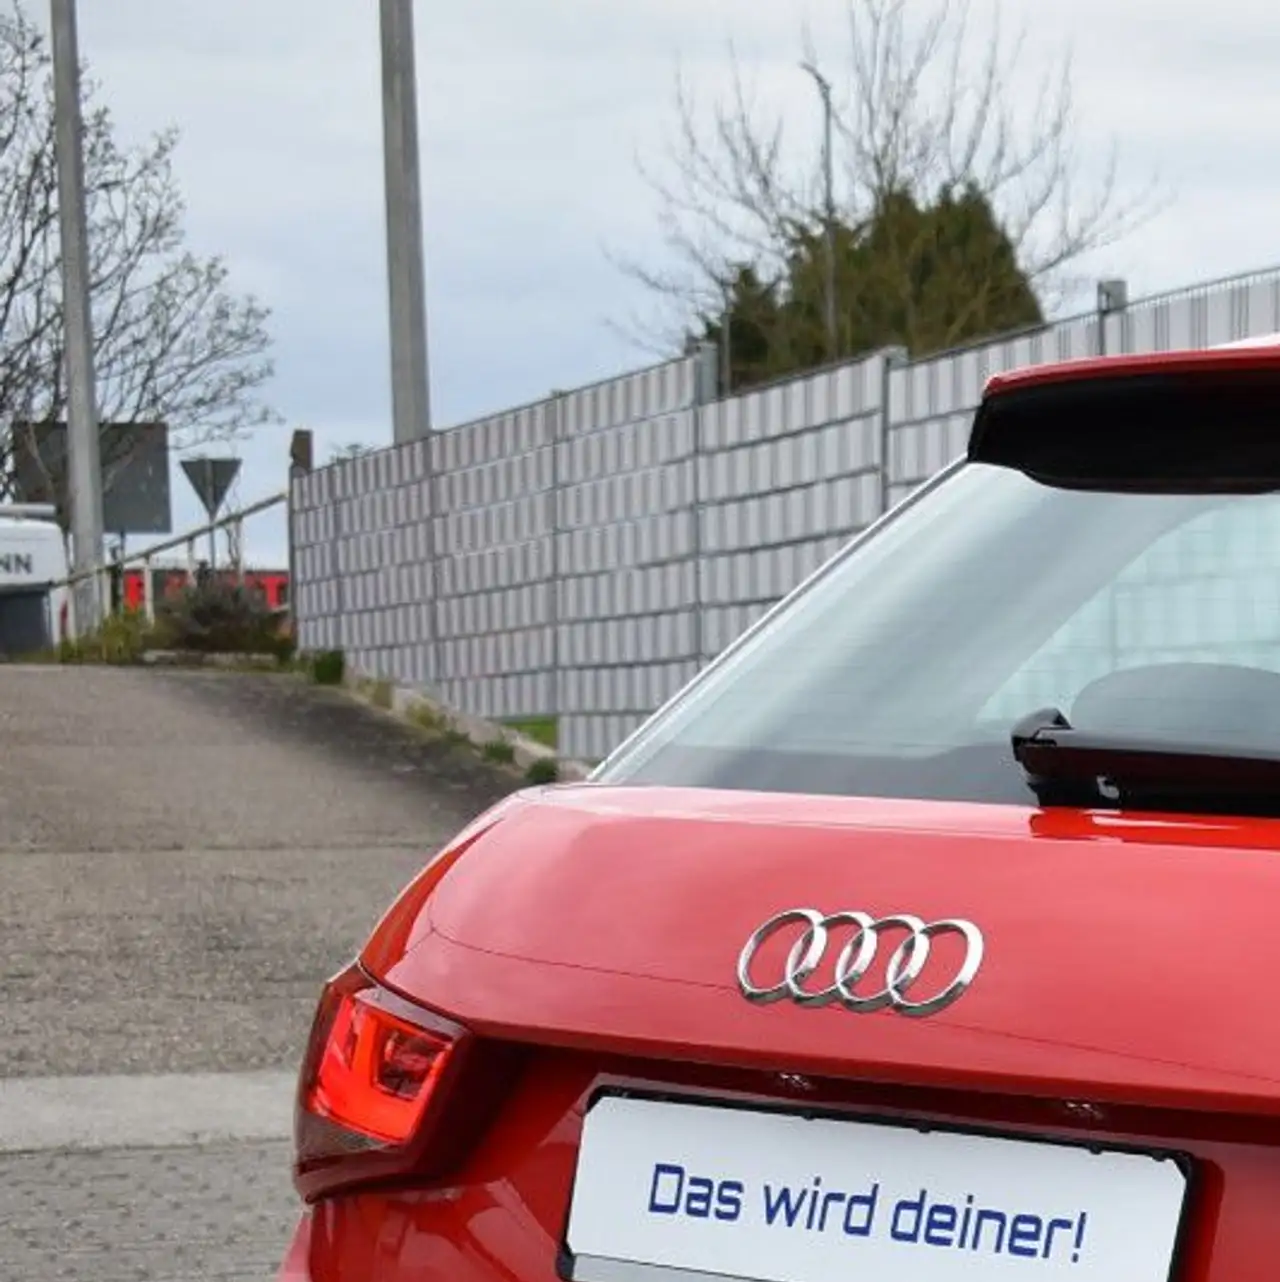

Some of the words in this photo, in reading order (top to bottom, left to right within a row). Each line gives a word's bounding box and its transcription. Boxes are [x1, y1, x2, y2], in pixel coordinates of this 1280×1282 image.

[649, 1163, 743, 1222] Das
[765, 1177, 878, 1237] wird
[890, 1190, 1087, 1262] deiner!
